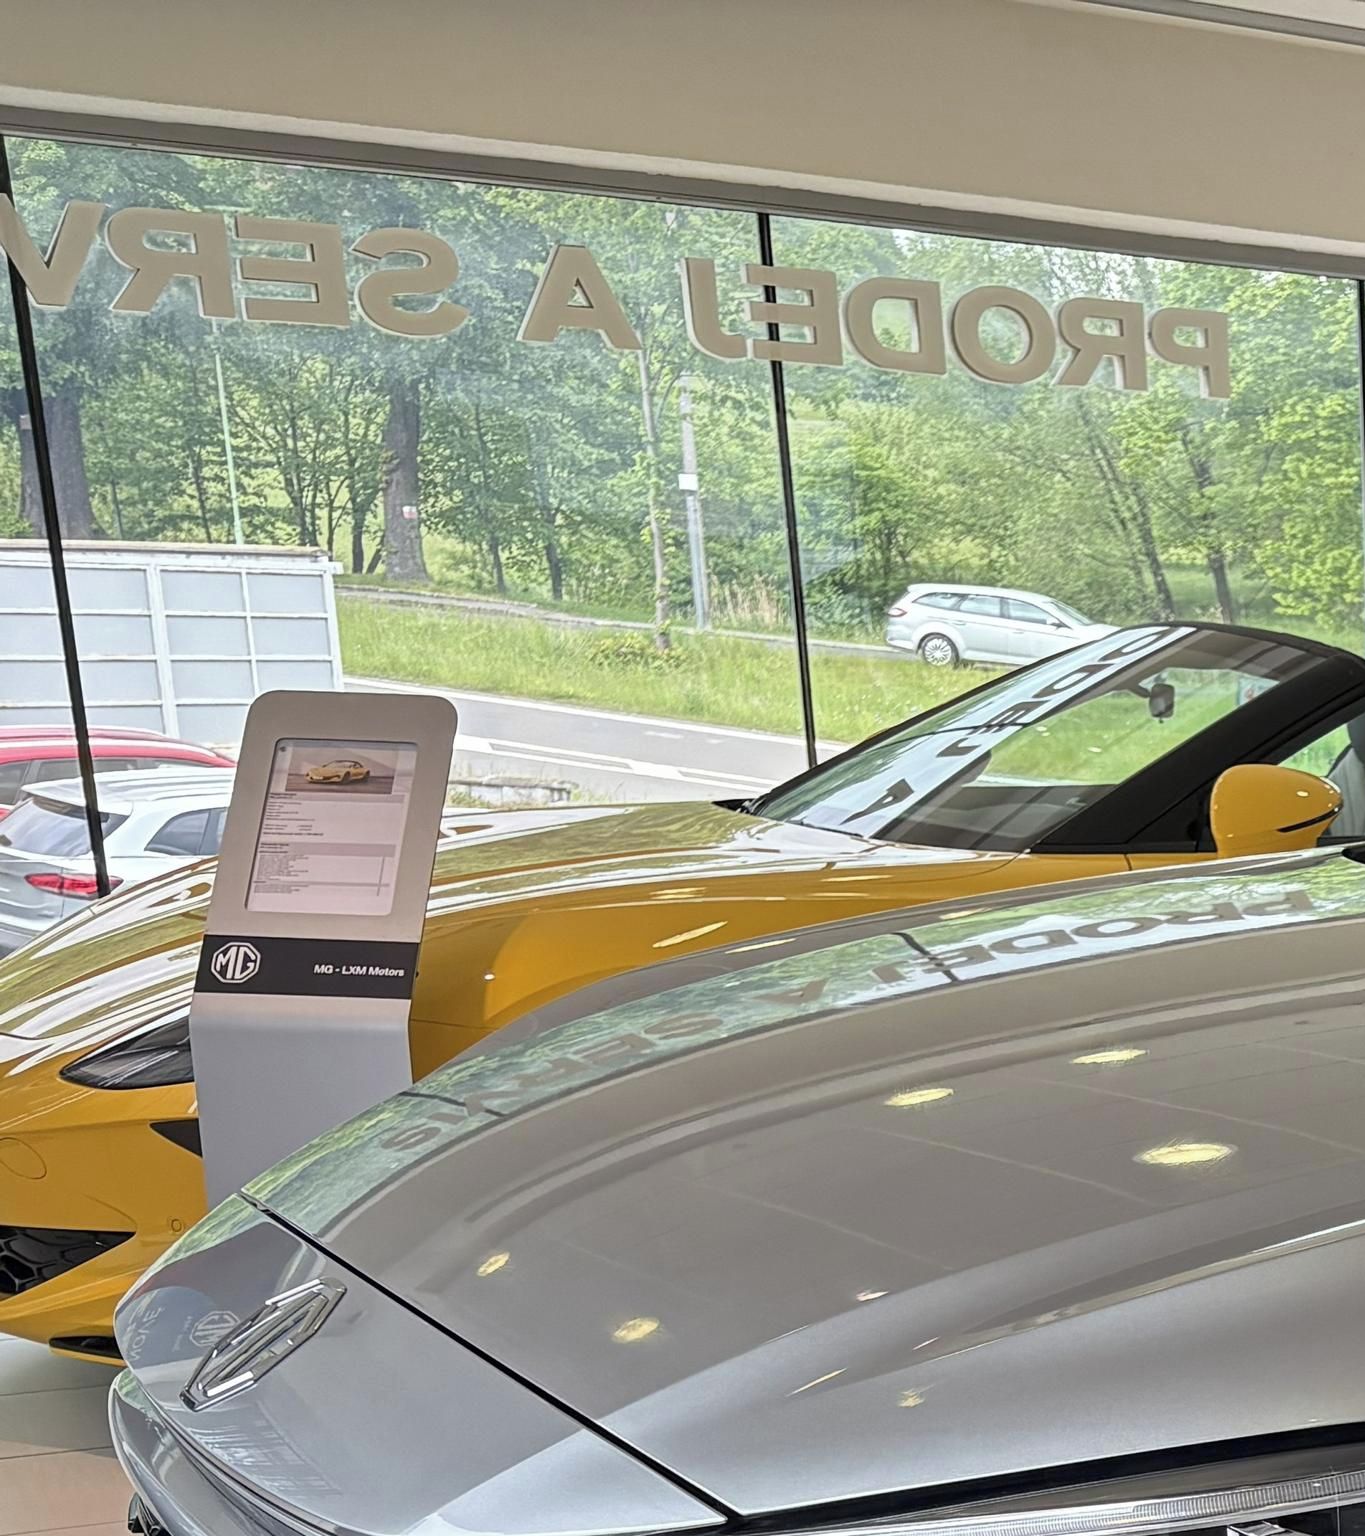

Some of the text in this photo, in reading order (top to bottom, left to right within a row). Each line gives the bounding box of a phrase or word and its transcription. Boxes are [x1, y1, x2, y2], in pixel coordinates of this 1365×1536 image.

[210, 941, 261, 984] MG
[314, 963, 333, 975] MG
[341, 965, 367, 976] LXM
[368, 966, 404, 977] Motors
